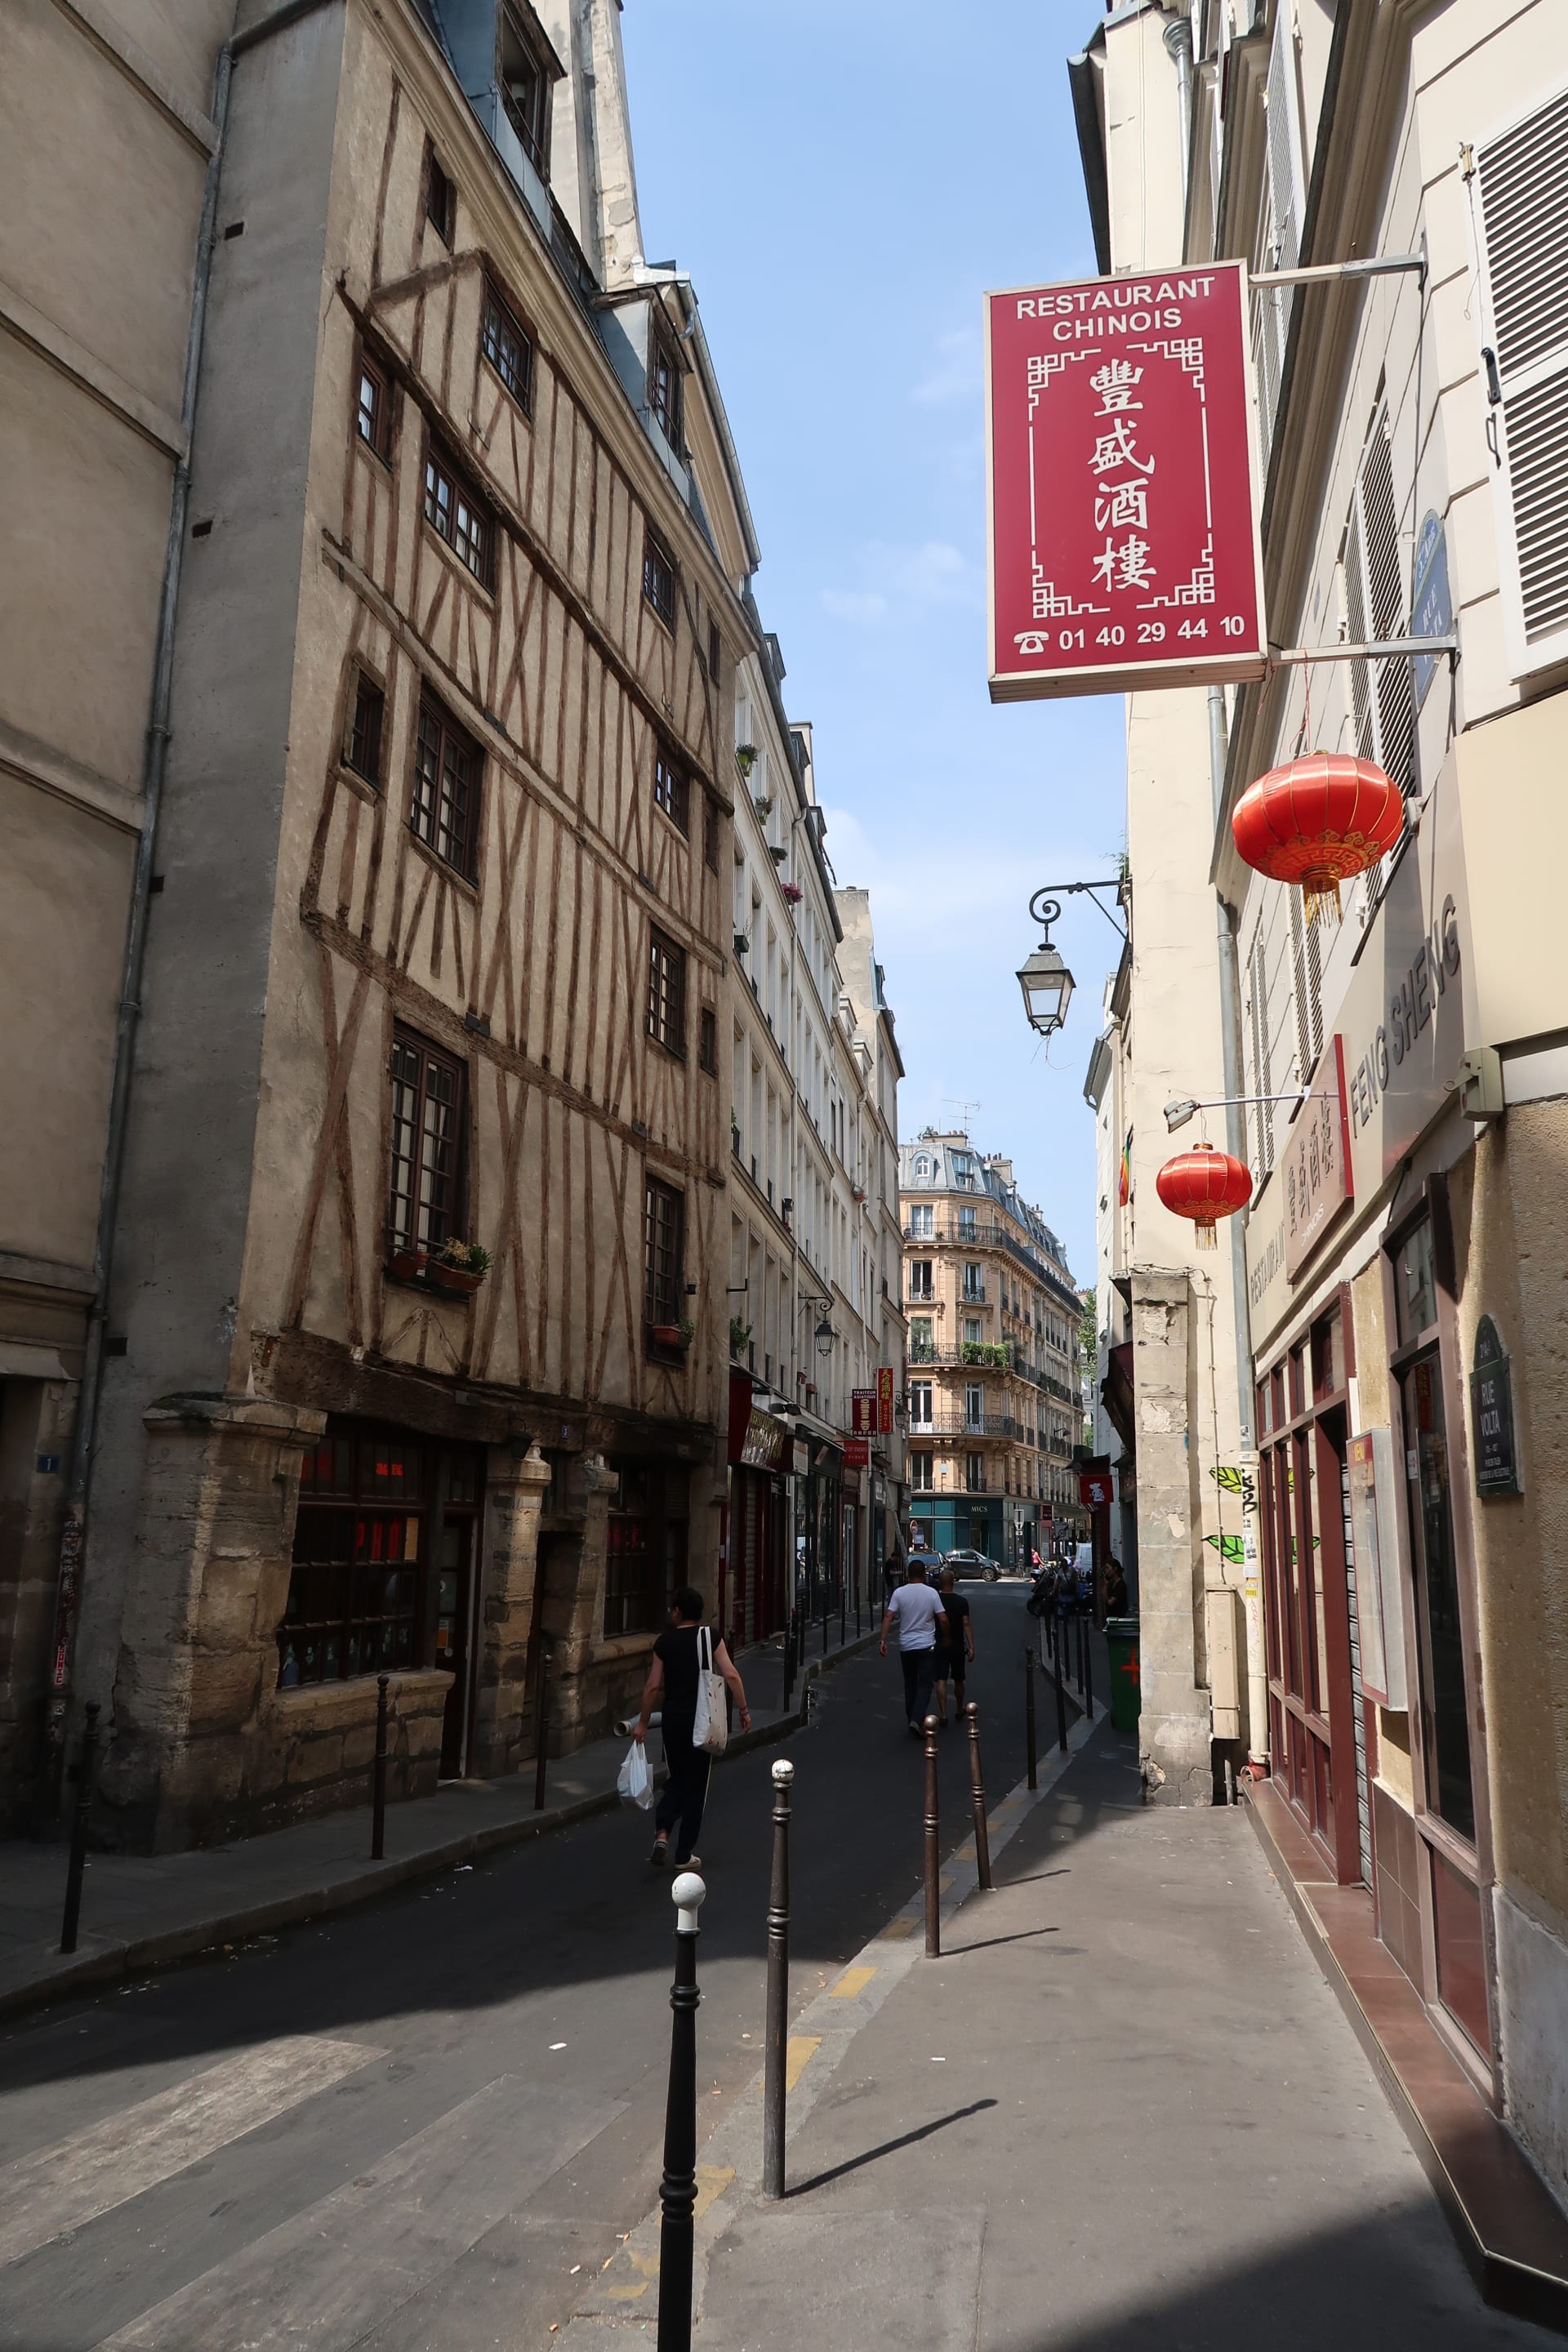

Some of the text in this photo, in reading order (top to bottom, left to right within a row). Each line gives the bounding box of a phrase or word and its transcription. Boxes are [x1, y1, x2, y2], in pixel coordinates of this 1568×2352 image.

[1016, 276, 1216, 319] RESTAURANT
[1052, 307, 1183, 341] CHINOIS
[1087, 358, 1157, 593] 豐盛酒樓
[1058, 615, 1245, 650] 01 40 29 44 10
[1350, 1025, 1388, 1139] FENG
[1391, 893, 1460, 1066] SHENG
[1301, 1202, 1324, 1247] CHINOIS
[1481, 1379, 1494, 1406] RUE
[1480, 1410, 1500, 1437] VOLTA
[47, 1457, 52, 1471] 1
